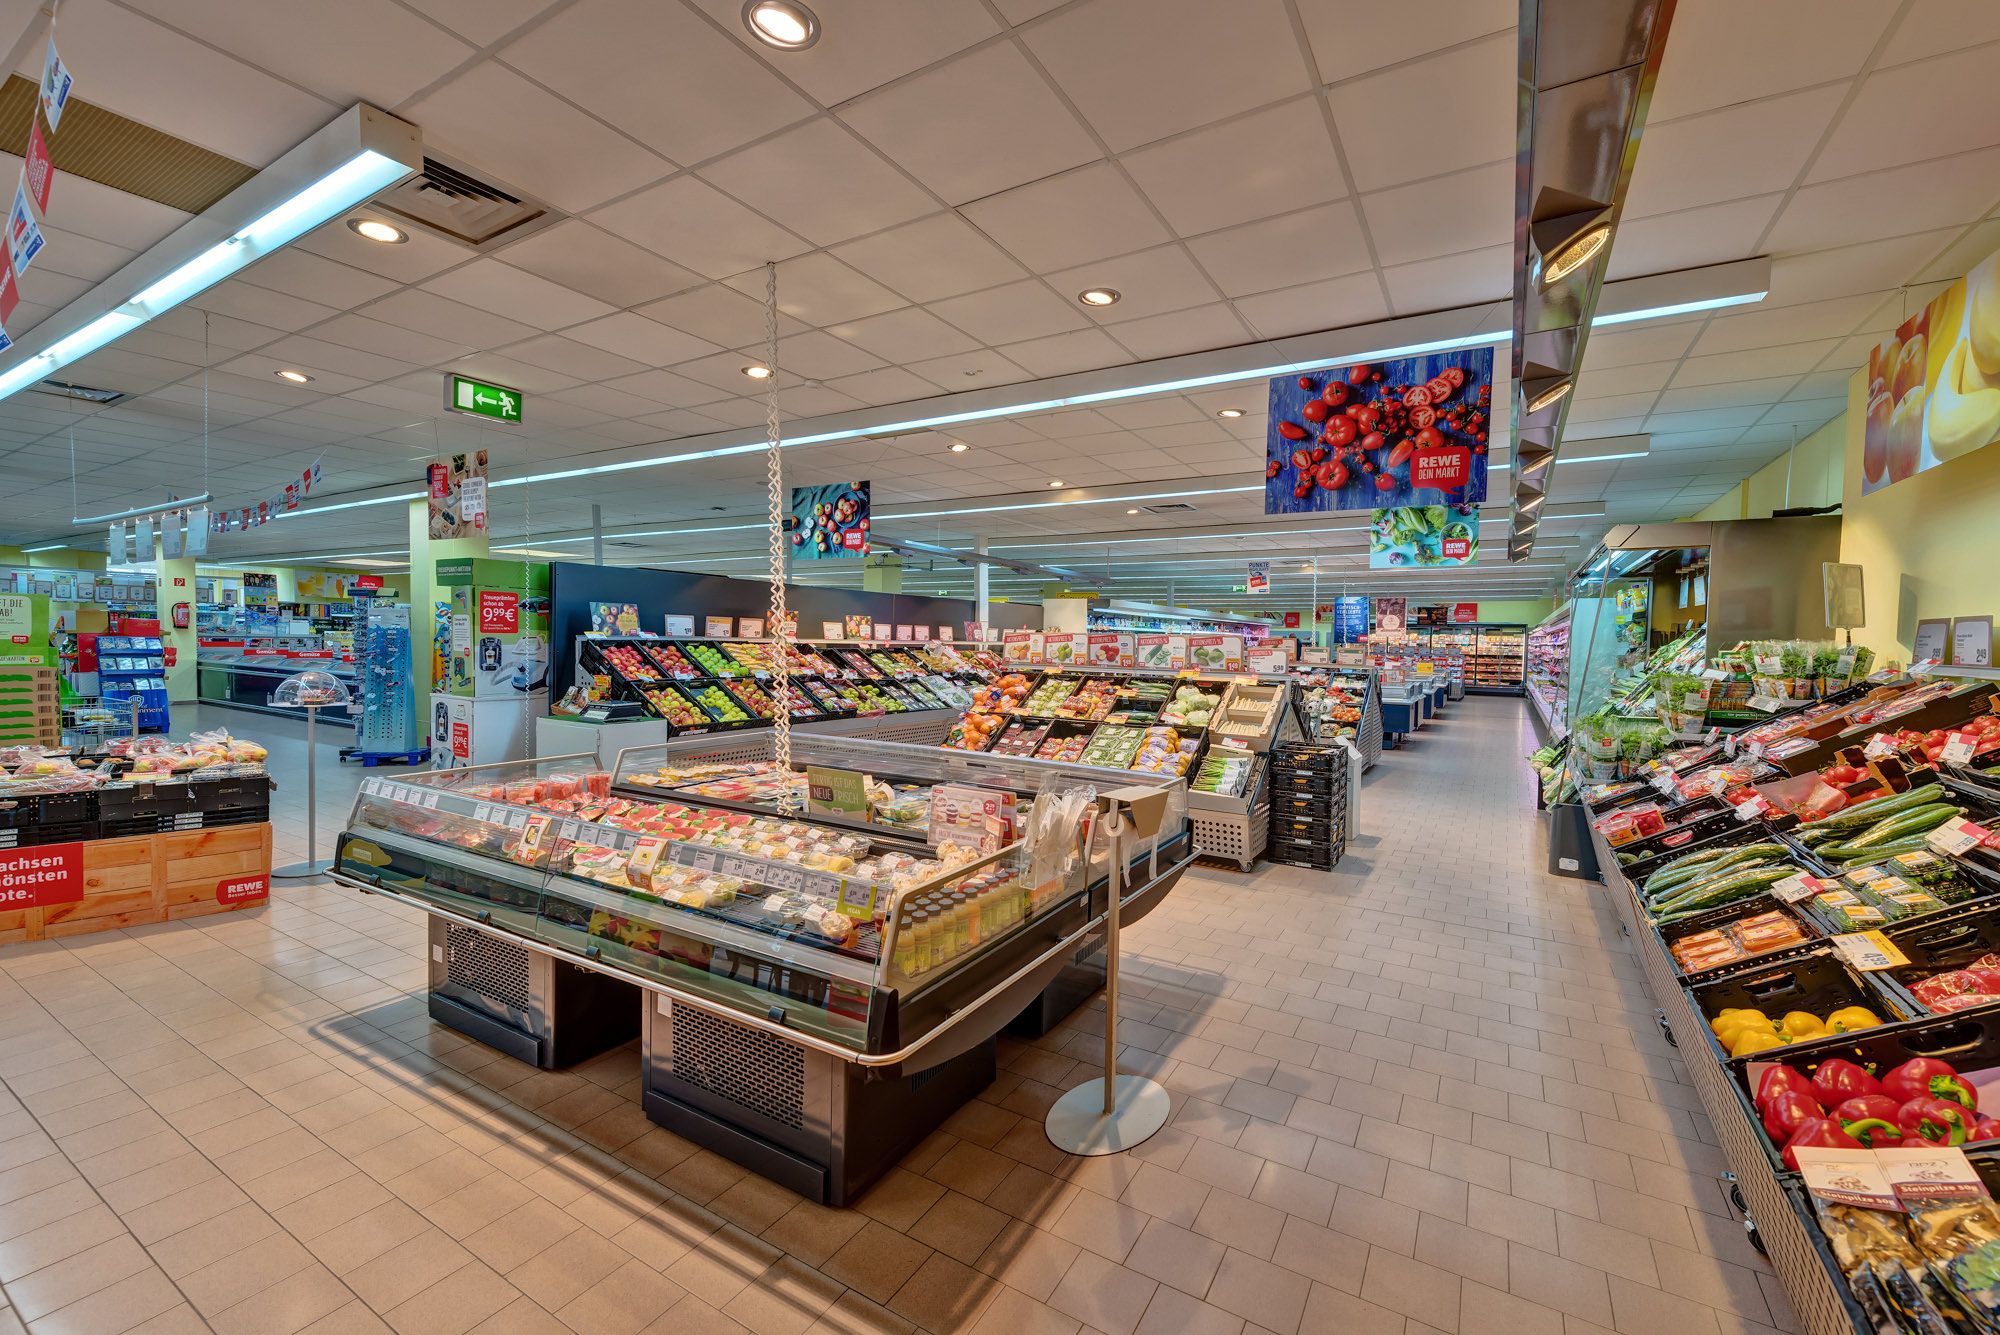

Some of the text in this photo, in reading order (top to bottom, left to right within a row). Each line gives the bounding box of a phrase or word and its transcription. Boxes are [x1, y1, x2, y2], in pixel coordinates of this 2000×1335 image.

[1419, 454, 1460, 468] REWE
[1418, 466, 1460, 480] DEIN MARKT
[10, 599, 23, 608] DIE
[813, 774, 857, 789] FERTIG IST DAS
[813, 787, 859, 805] NEUE FRISCH
[0, 870, 68, 887] önsten
[227, 881, 263, 894] REWE
[847, 907, 861, 915] VEGAN
[1901, 1184, 1956, 1193] Steinpilze
[1820, 1190, 1874, 1204] Steinpilze
